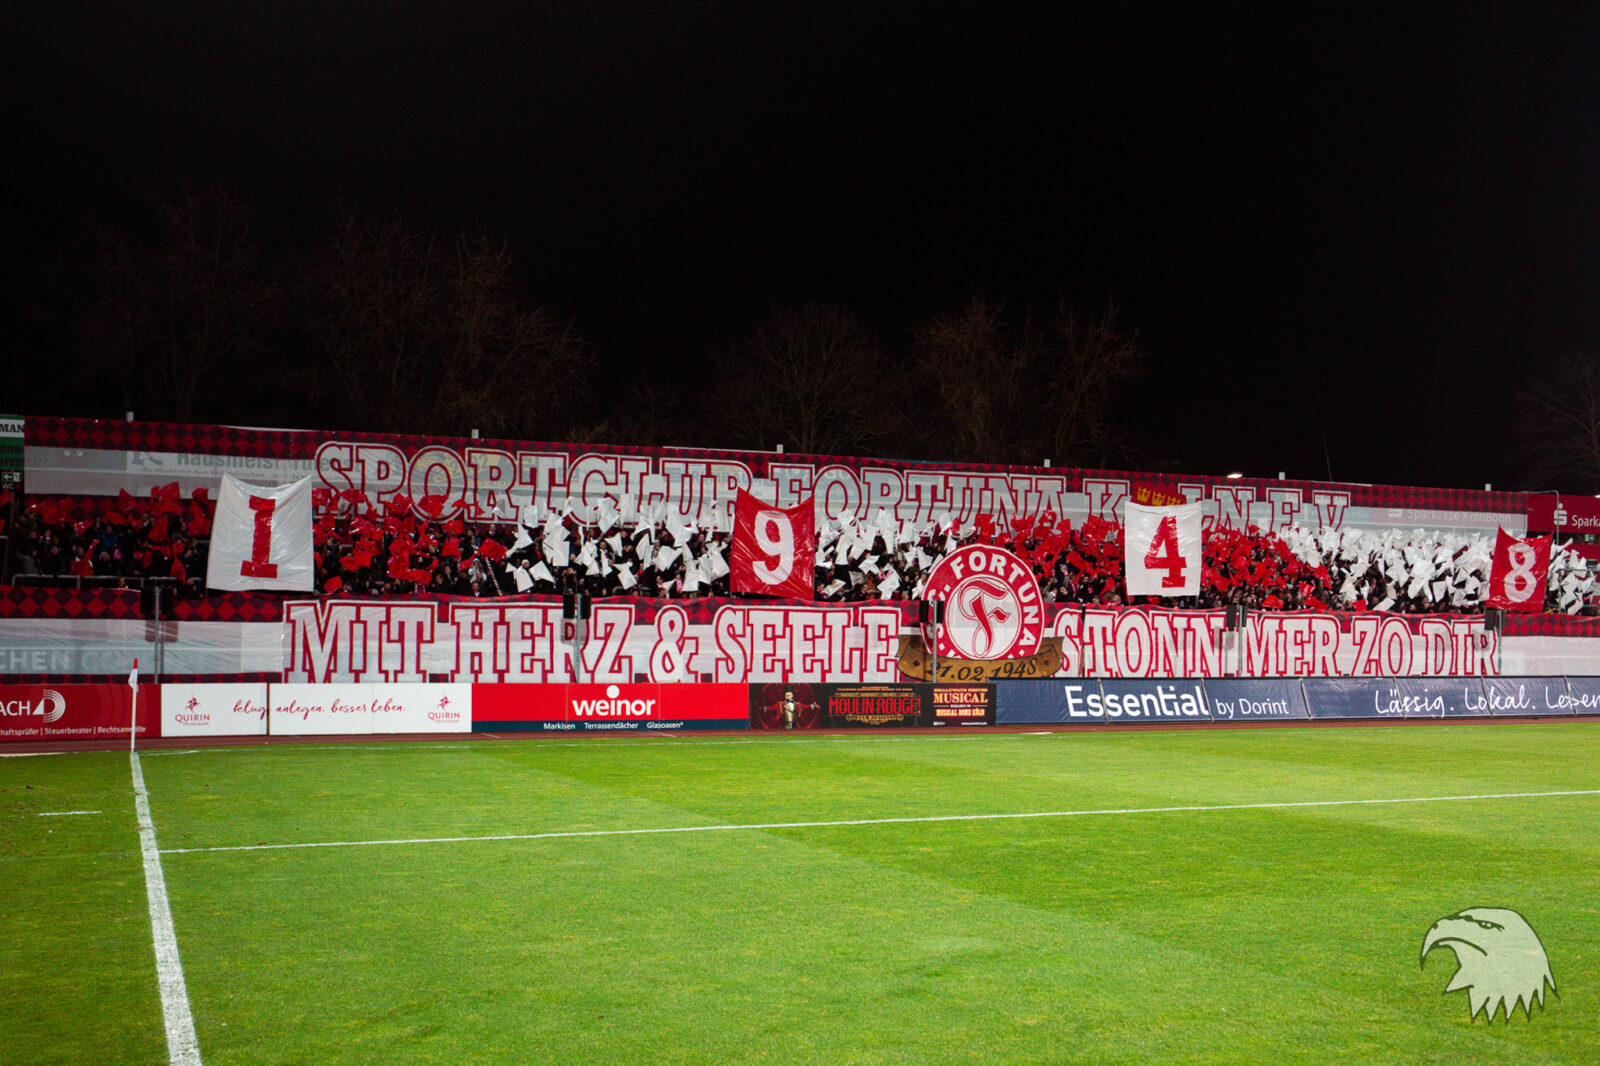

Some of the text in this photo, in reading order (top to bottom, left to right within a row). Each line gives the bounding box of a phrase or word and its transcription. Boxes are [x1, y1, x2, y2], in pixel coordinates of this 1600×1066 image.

[769, 463, 1065, 542] FORTUNA
[752, 509, 795, 585] 9
[1143, 514, 1187, 588] 4
[1504, 542, 1537, 603] 8
[950, 550, 1040, 646] FORTUNA
[284, 600, 901, 683] MIT HERZ & SEELE
[1052, 608, 1500, 678] STONN MER ZO DIR
[331, 698, 367, 713] besser
[371, 697, 406, 713] leben.
[572, 685, 656, 716] weinor
[829, 697, 921, 715] MOULIN ROUGE!
[933, 692, 988, 703] MUSICAL
[1064, 685, 1290, 719] Essential by Dorint
[44, 726, 92, 735] Steuerberater
[175, 713, 210, 723] QUIRIN
[427, 712, 461, 720] QUIRIN
[543, 722, 576, 730] Markisen
[584, 721, 639, 730] Terrassendächer
